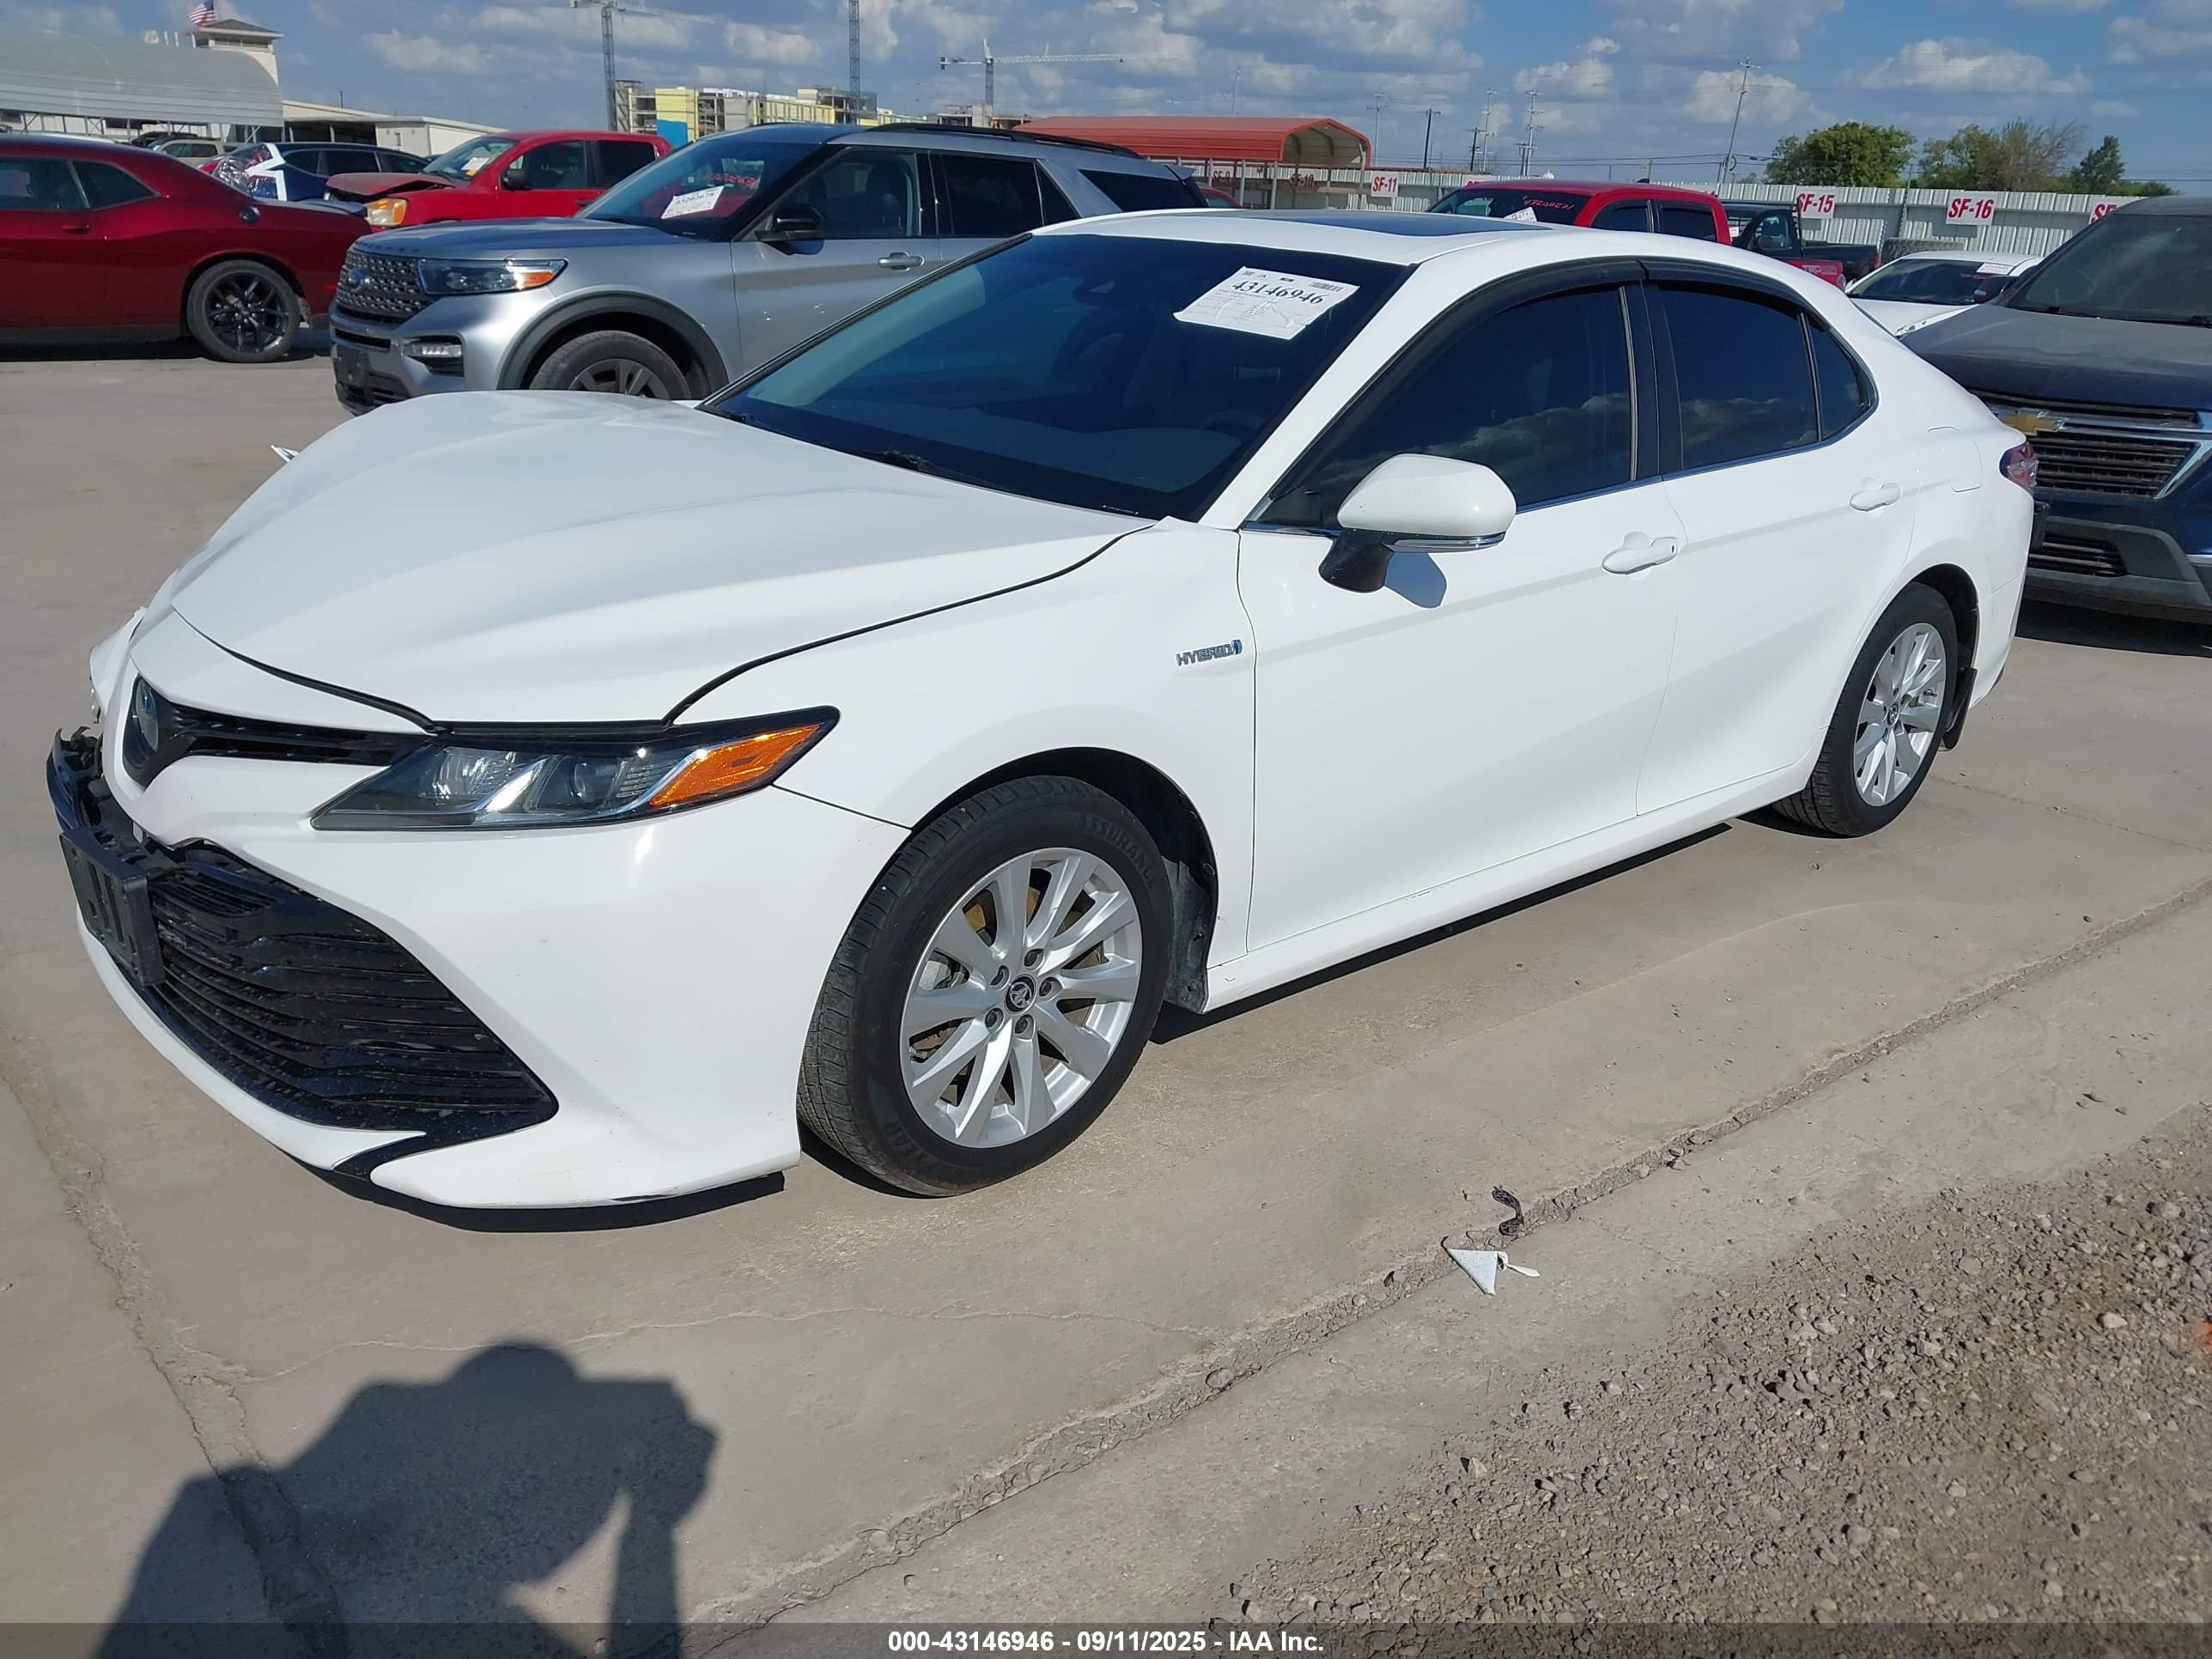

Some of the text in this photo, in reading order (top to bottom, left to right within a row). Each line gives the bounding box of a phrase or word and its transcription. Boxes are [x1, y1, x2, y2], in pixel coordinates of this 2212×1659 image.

[1373, 177, 1399, 192] SF-11
[1796, 193, 1836, 213] SF-15
[1948, 198, 1995, 219] SF-16
[1231, 280, 1328, 305] 43146946
[1176, 643, 1234, 666] HYBRID
